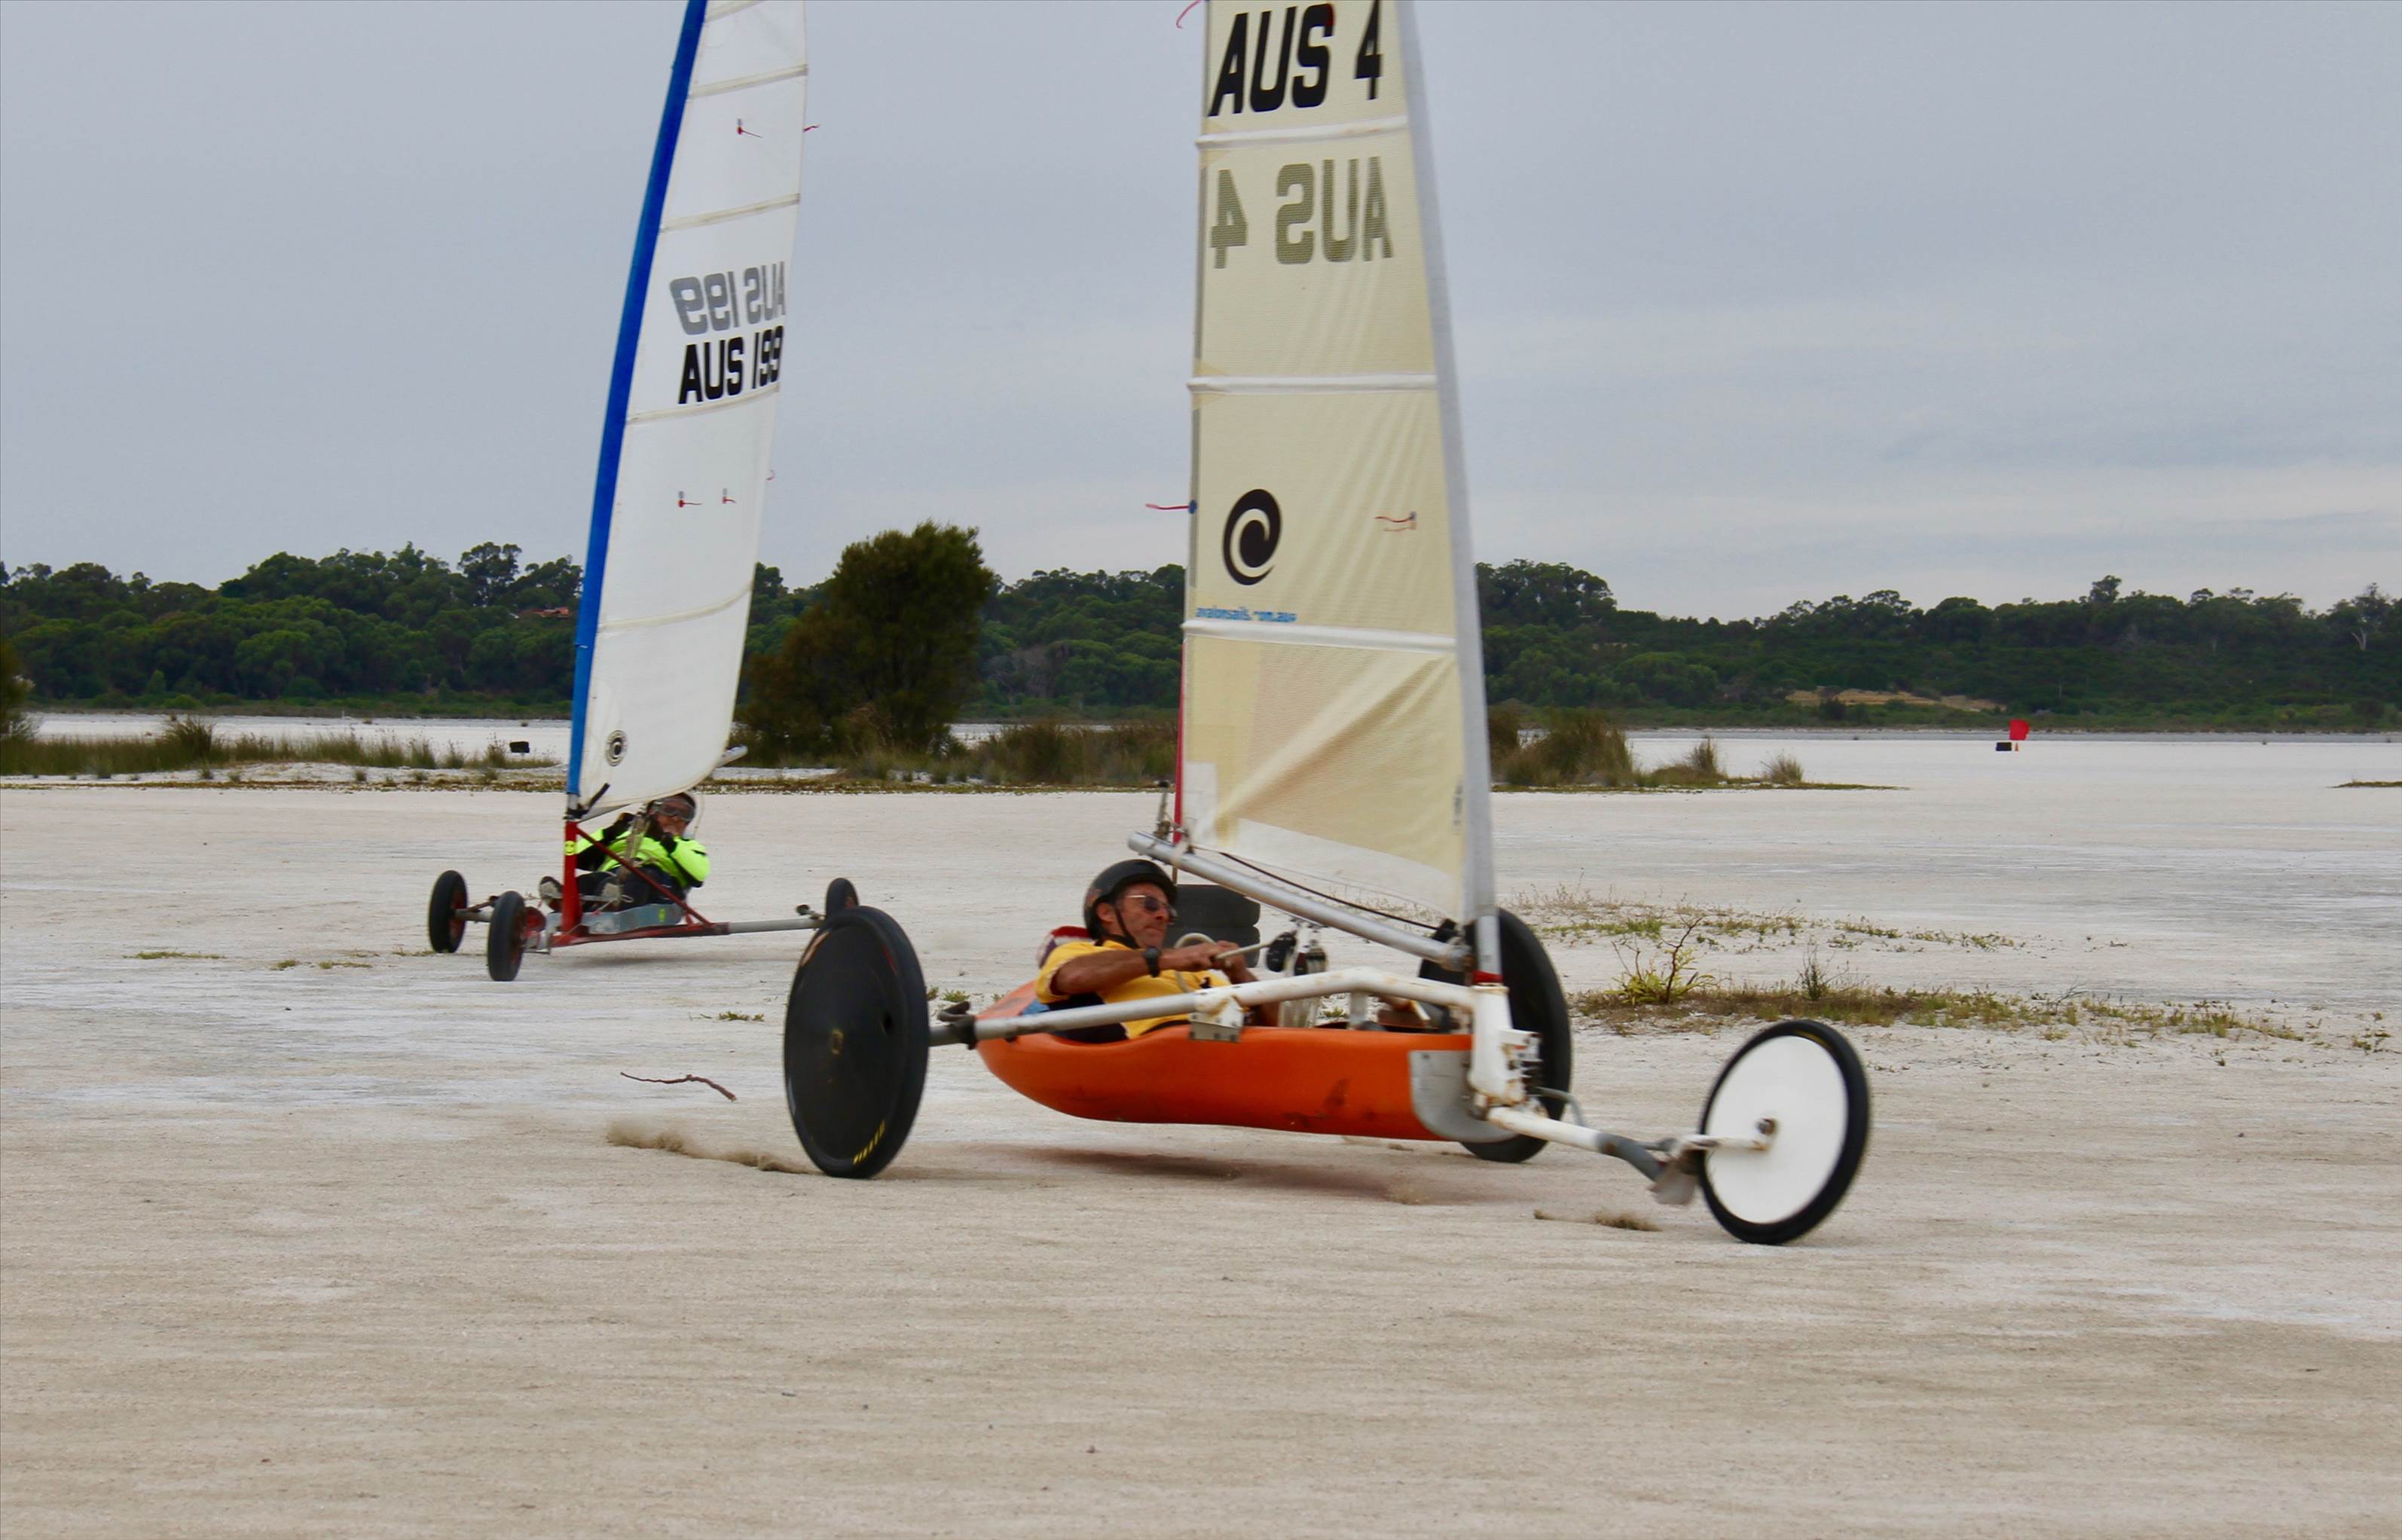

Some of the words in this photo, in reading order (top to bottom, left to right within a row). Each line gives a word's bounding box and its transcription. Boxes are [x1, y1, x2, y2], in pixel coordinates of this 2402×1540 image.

[1207, 3, 1336, 118] AUS
[1354, 0, 1383, 100] 4
[678, 337, 744, 405] AUS
[752, 325, 784, 390] 199
